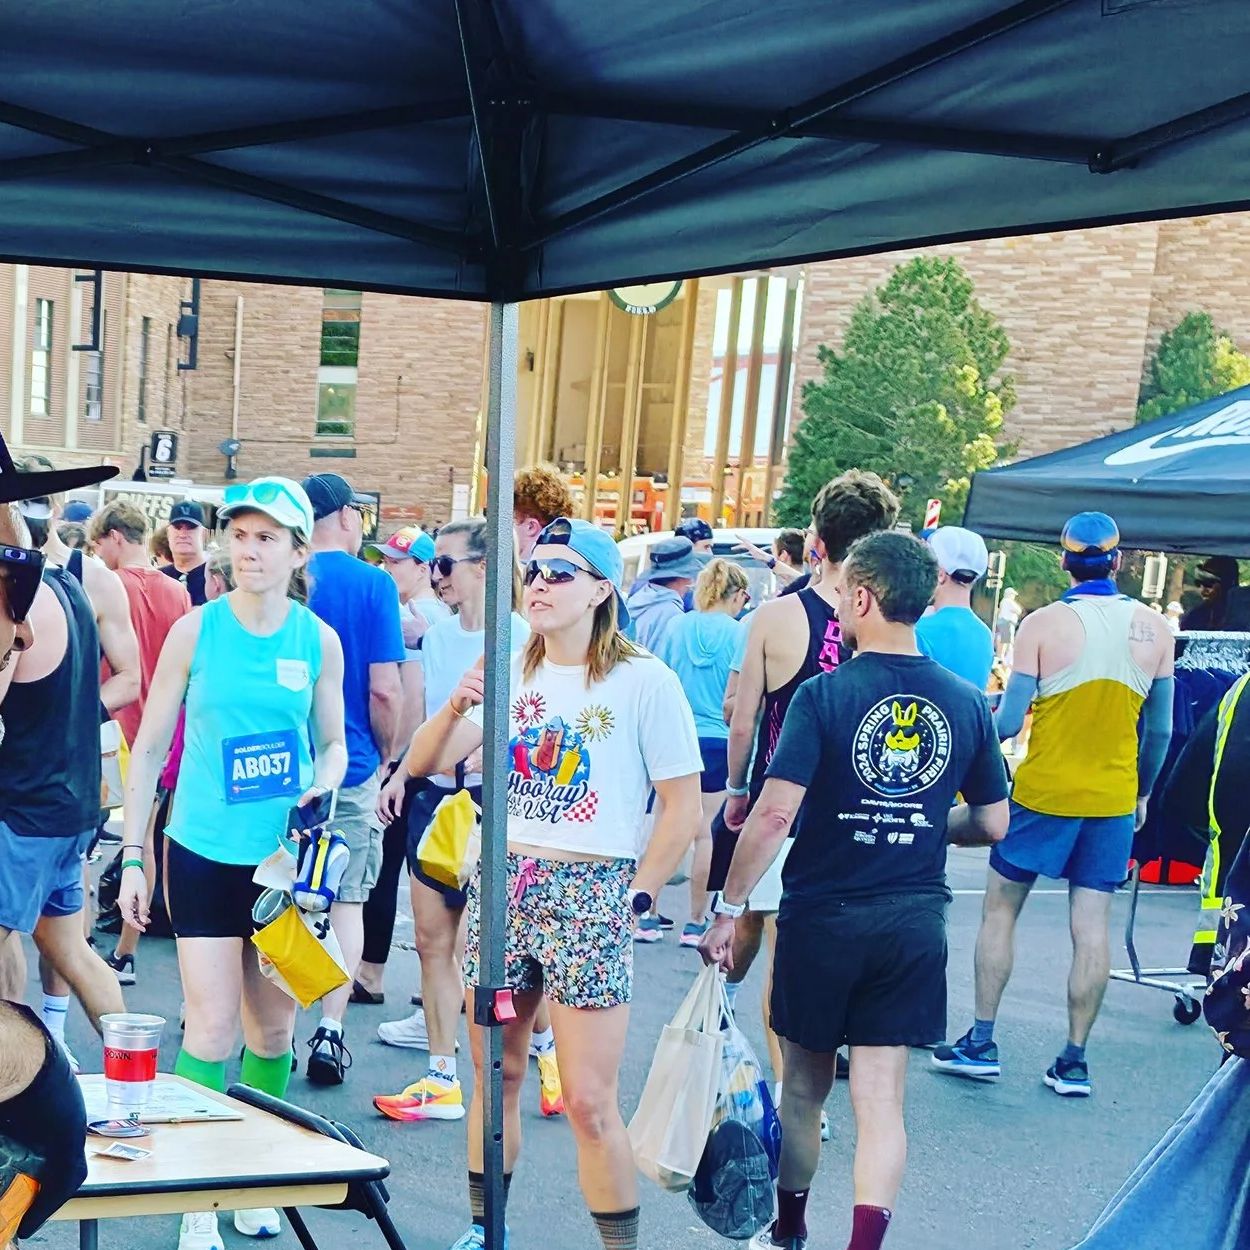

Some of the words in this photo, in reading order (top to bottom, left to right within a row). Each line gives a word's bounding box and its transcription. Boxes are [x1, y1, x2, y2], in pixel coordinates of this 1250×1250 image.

[155, 438, 173, 462] 6
[857, 704, 890, 751] SPRING
[921, 705, 949, 756] PRAIRIE
[232, 752, 291, 780] AB037
[857, 752, 878, 782] 2024
[918, 756, 944, 785] FIRE
[507, 772, 588, 811] Hooray
[523, 800, 562, 824] USA
